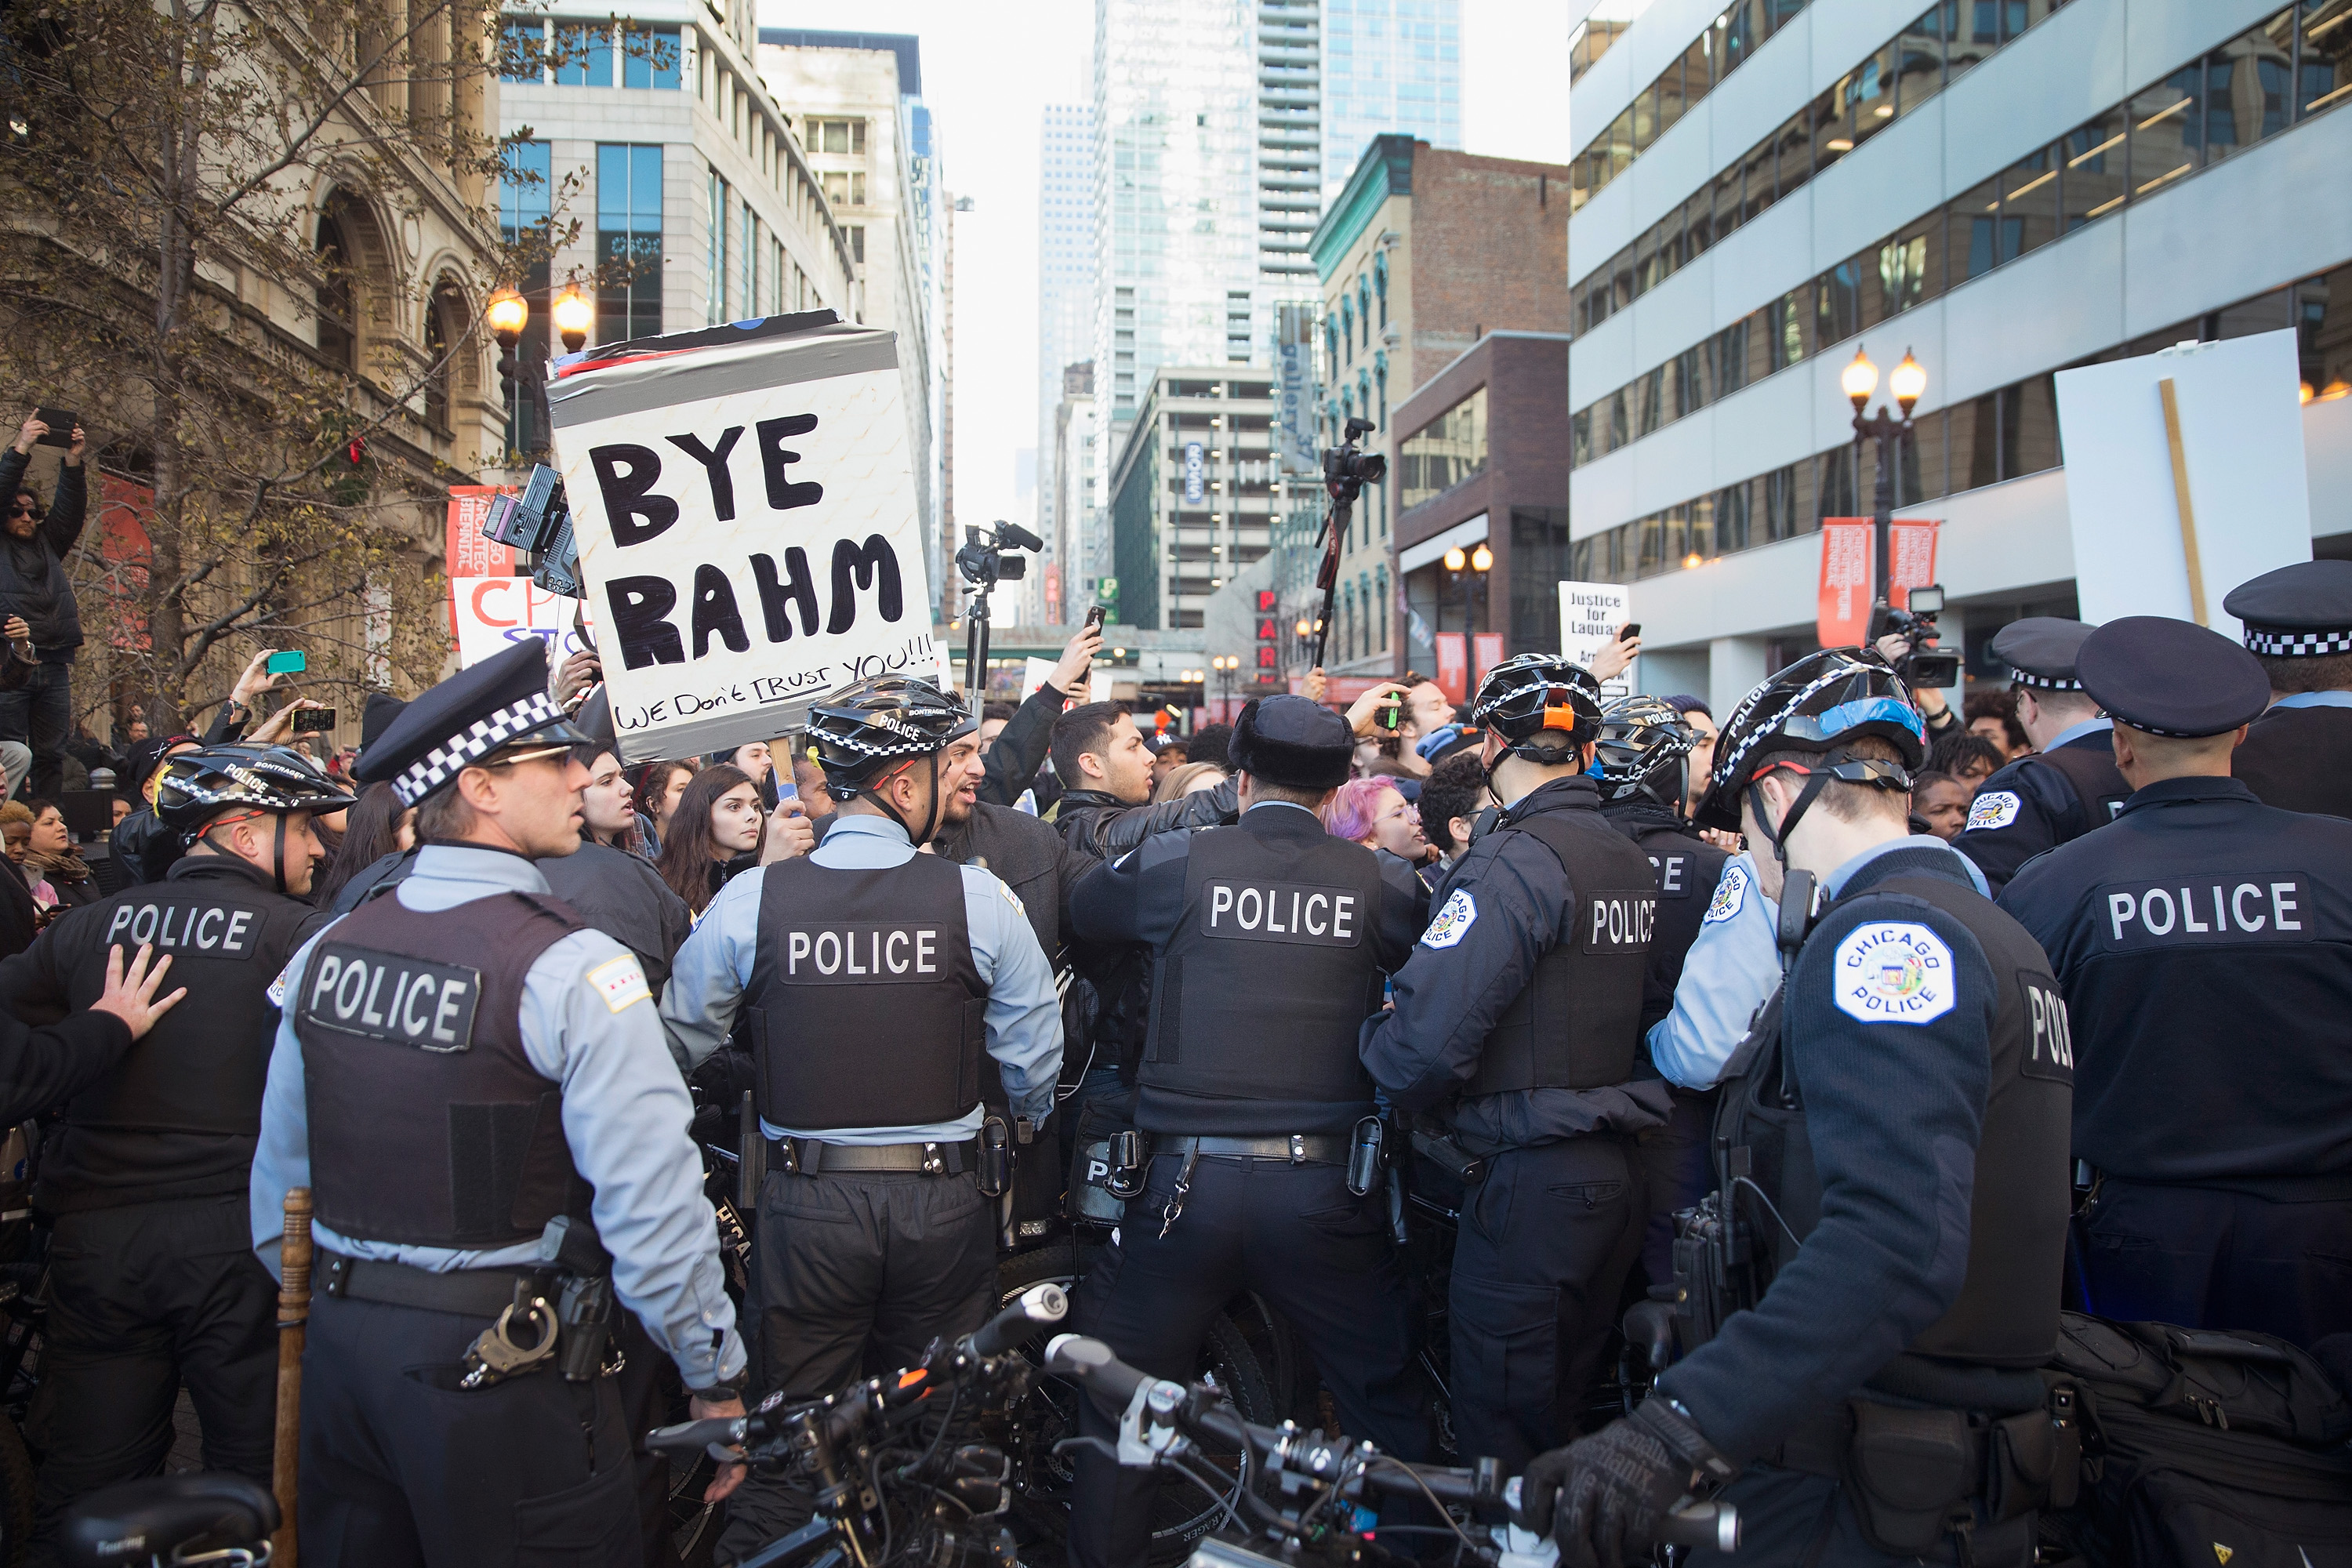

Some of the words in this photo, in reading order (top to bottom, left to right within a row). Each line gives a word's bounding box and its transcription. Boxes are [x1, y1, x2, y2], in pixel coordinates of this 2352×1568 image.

[1281, 344, 1303, 434] gallery
[1297, 434, 1314, 460] 37
[590, 413, 823, 548] BYE
[458, 497, 472, 570] BIENNIAL
[473, 498, 488, 577] ARCHITECT
[1825, 528, 1842, 586] BIENNIAL
[1853, 528, 1865, 584] CHICAGO
[1894, 528, 1908, 587] BIENNIAL
[1918, 528, 1933, 586] CHICAGO
[1837, 528, 1851, 620] ARCHITECTURE
[605, 534, 903, 671] RAHM
[1571, 593, 1621, 608] Justice
[1587, 607, 1606, 621] for
[674, 684, 748, 716] Don't
[748, 666, 831, 704] TRUST
[908, 708, 946, 717] BONTRAGER
[1728, 680, 1772, 738] POLICE
[878, 714, 920, 742] POLICE
[1645, 712, 1675, 725] POLICE
[223, 762, 270, 794] POLICE
[253, 760, 306, 780] BONTRAGER
[1969, 815, 2005, 826] POLICE
[1972, 794, 2013, 812] CHICAGO
[105, 904, 254, 951] POLICE
[1210, 885, 1356, 938] POLICE
[1592, 899, 1657, 945] POLICE
[2108, 882, 2302, 940] POLICE
[789, 930, 937, 975] POLICE
[1847, 930, 1940, 969] CHICAGO
[310, 955, 467, 1042] POLICE
[1851, 985, 1937, 1014] POLICE
[2027, 985, 2074, 1071] POLI
